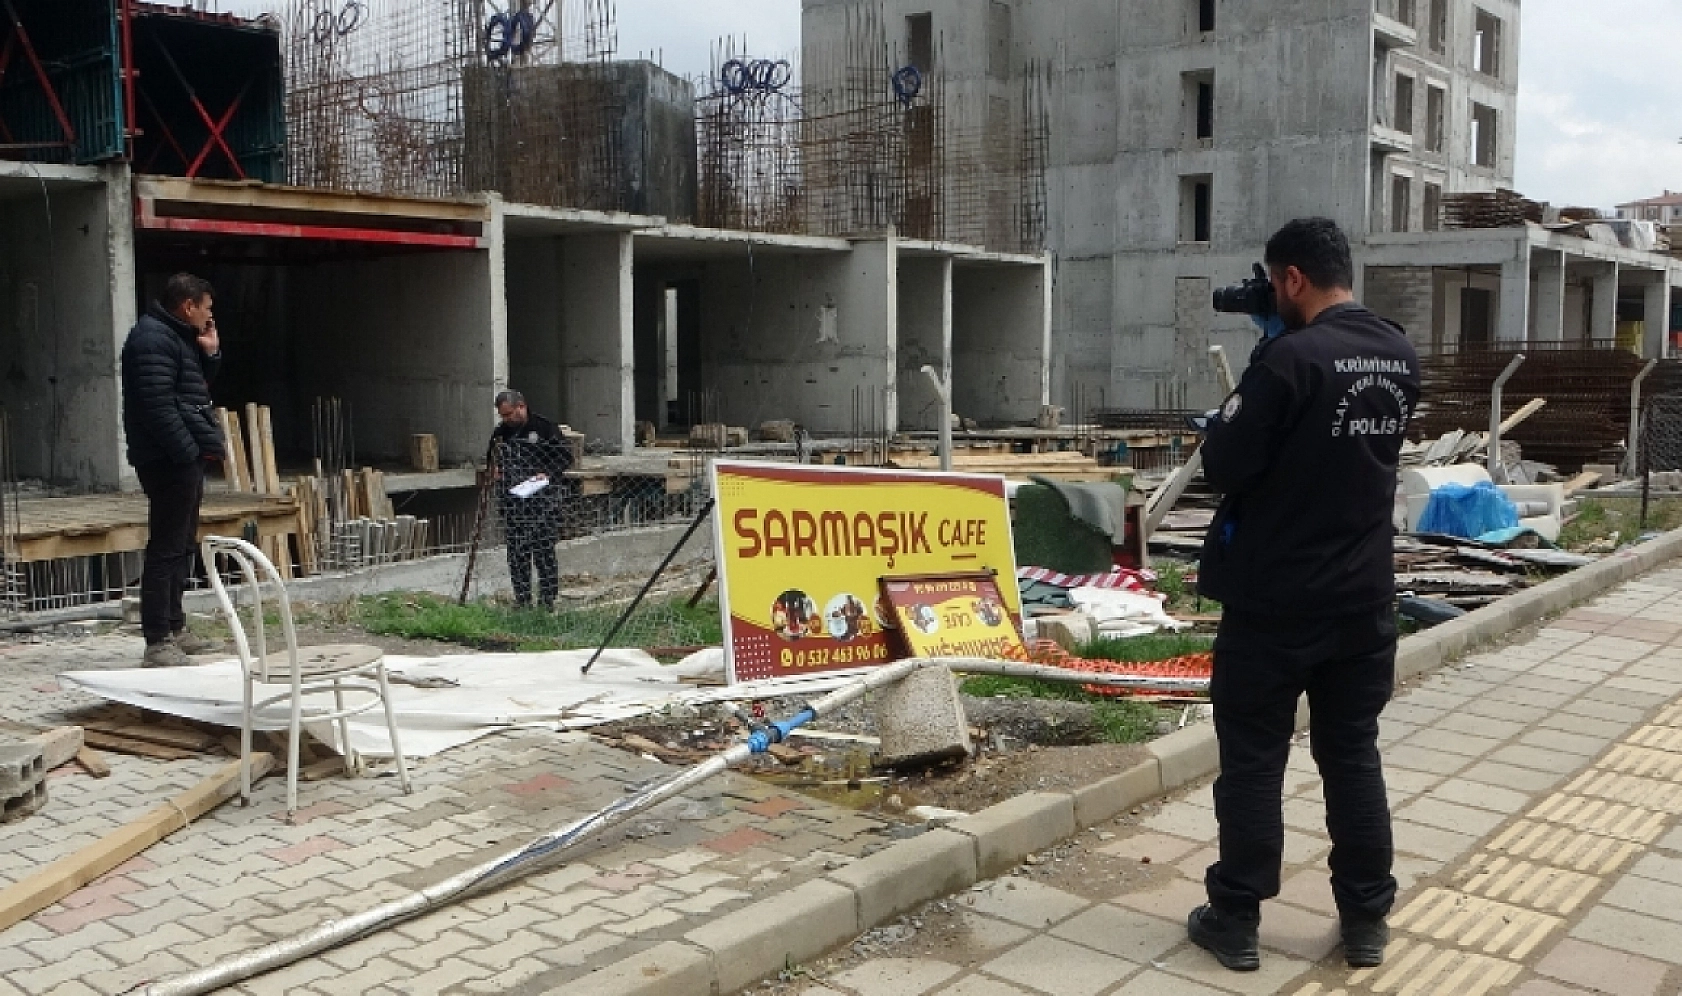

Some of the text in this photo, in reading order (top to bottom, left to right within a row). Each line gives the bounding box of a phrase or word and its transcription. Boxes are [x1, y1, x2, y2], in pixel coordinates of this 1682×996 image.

[1334, 355, 1411, 375] KRİMİNAL
[1348, 415, 1397, 437] POLİS
[734, 508, 987, 569] SARMAŞIK CAFE
[796, 649, 806, 667] 0
[808, 648, 829, 667] 532
[856, 644, 871, 660] 96
